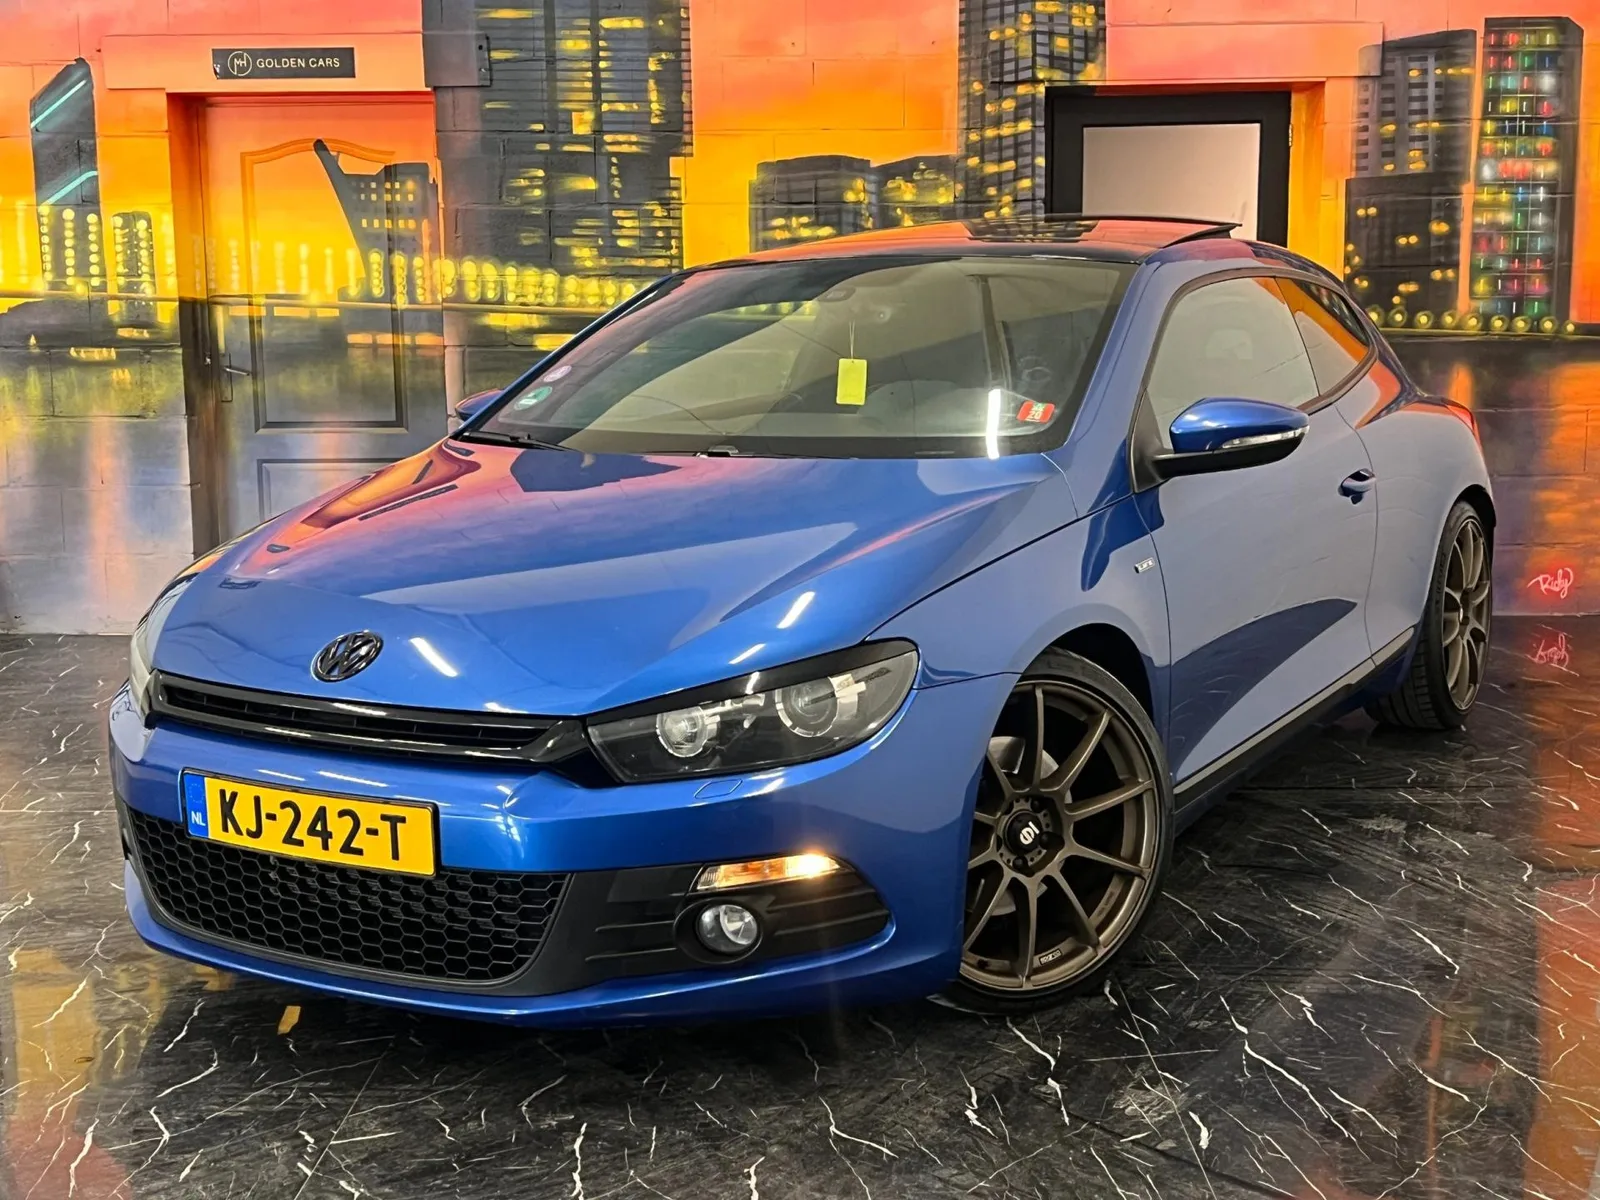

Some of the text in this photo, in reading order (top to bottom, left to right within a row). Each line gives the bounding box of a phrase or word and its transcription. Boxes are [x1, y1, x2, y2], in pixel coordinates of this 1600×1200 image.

[256, 57, 306, 68] GOLDEN
[308, 57, 341, 68] CARS
[191, 788, 407, 861] NL KJ-242-T
